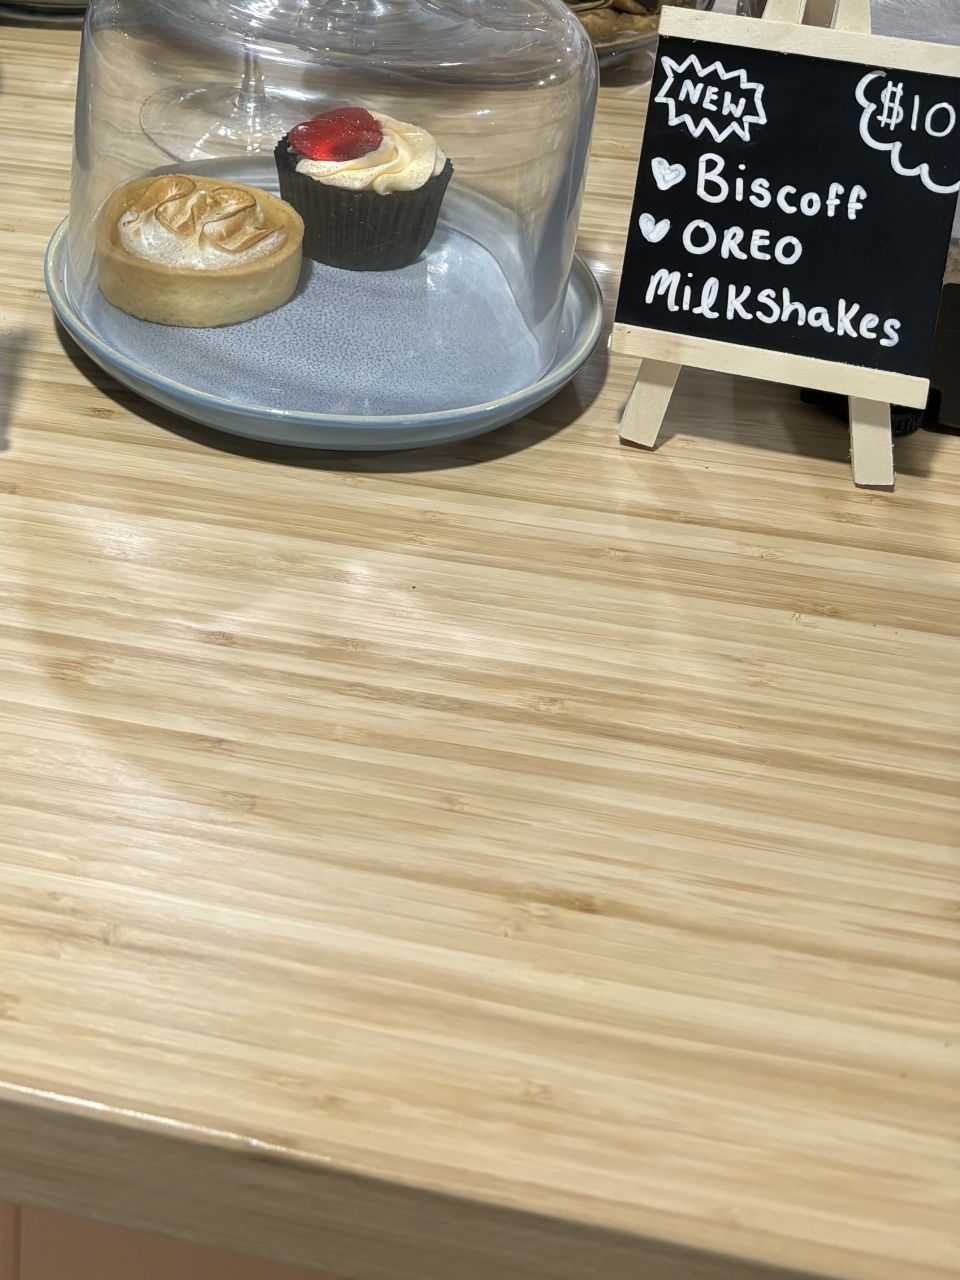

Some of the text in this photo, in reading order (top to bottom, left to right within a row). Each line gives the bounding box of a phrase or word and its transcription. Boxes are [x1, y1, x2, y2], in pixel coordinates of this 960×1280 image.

[679, 79, 747, 122] NEW
[877, 80, 956, 138] $10
[696, 152, 868, 220] Biscoff
[682, 219, 803, 265] OREO
